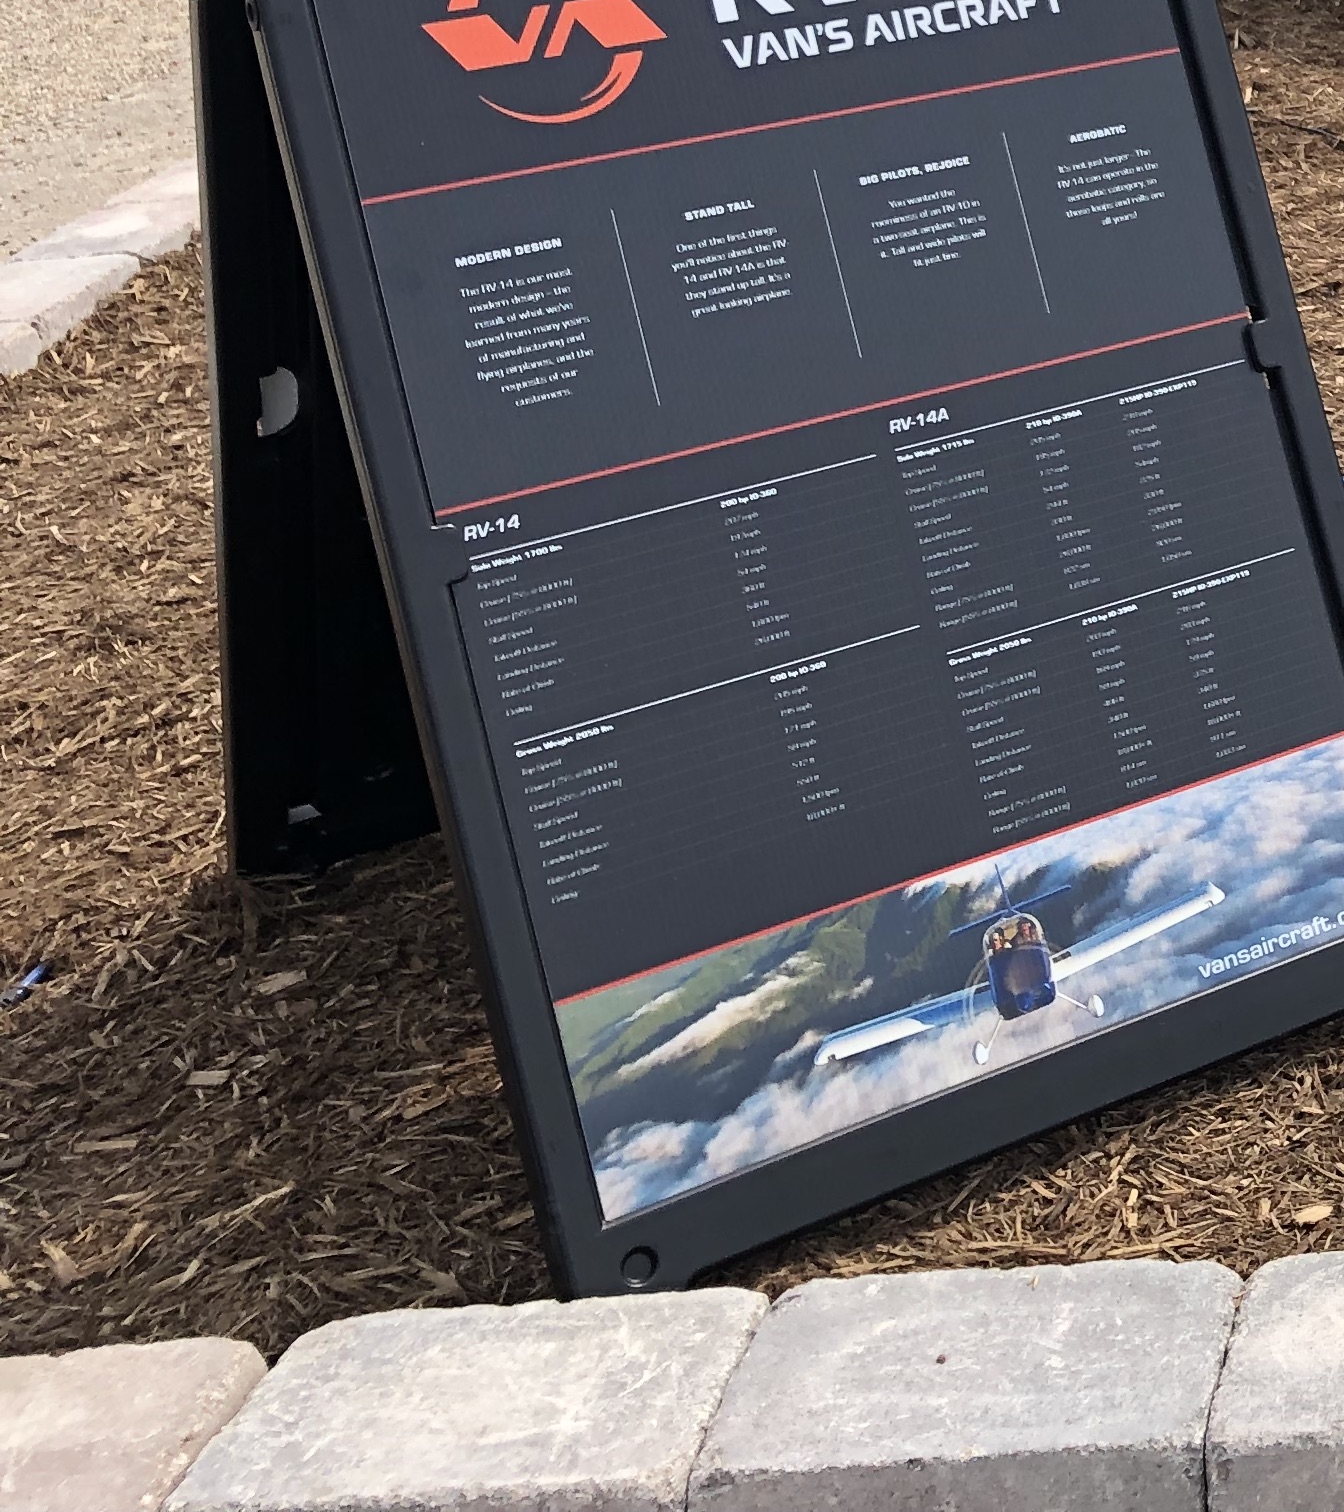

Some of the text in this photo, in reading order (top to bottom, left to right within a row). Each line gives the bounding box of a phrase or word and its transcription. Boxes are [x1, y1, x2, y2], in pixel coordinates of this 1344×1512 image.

[722, 17, 855, 69] VAN'S
[1069, 125, 1126, 144] AEROBATIC
[859, 156, 970, 186] BIG PILOTS, REJOICE
[684, 200, 755, 221] STAND TALL
[455, 238, 562, 268] MODERN DESIGN
[888, 407, 950, 435] RV-14A
[463, 513, 521, 542] RV-14
